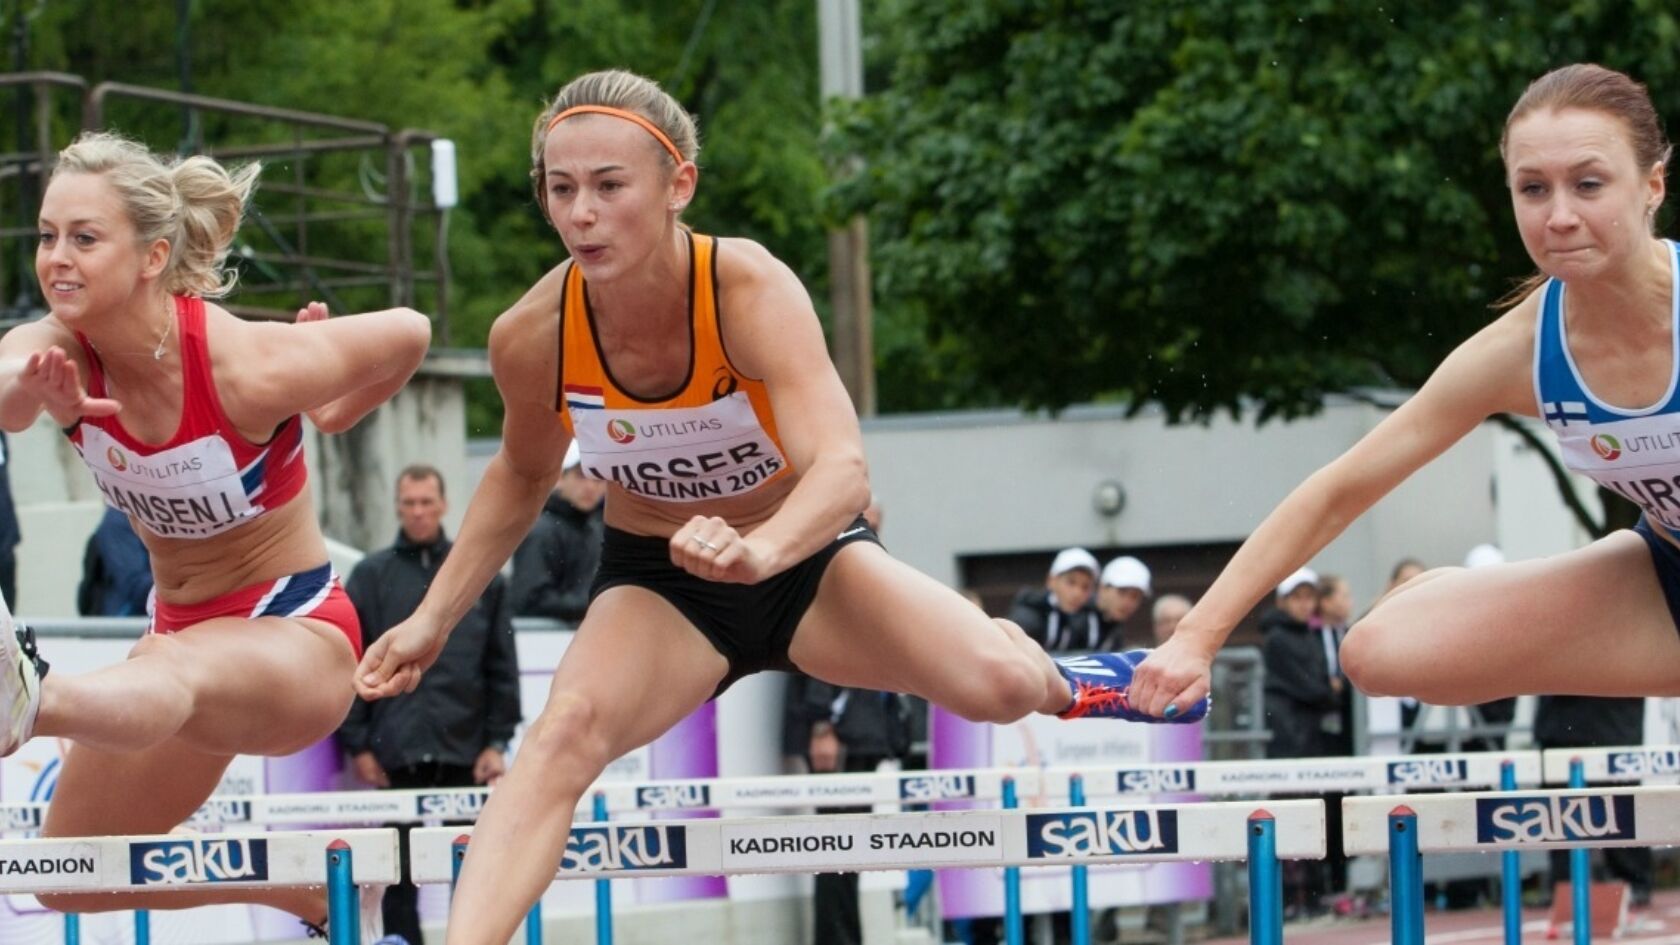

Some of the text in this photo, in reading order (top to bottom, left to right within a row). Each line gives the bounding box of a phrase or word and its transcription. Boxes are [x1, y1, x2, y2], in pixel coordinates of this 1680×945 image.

[640, 418, 722, 438] UTILITAS
[130, 457, 203, 479] UTILITAS
[588, 442, 766, 484] VISSER
[726, 457, 780, 492] 2015
[95, 472, 217, 525] HANSEN
[1122, 769, 1190, 792] saku
[1393, 760, 1461, 783] saku
[641, 786, 705, 807] saku
[904, 775, 970, 799] saku
[1491, 794, 1621, 843] saku
[730, 830, 995, 854] KADRIORU STAADION
[1040, 810, 1165, 857] saku
[143, 838, 256, 884] saku
[558, 825, 673, 872] saku
